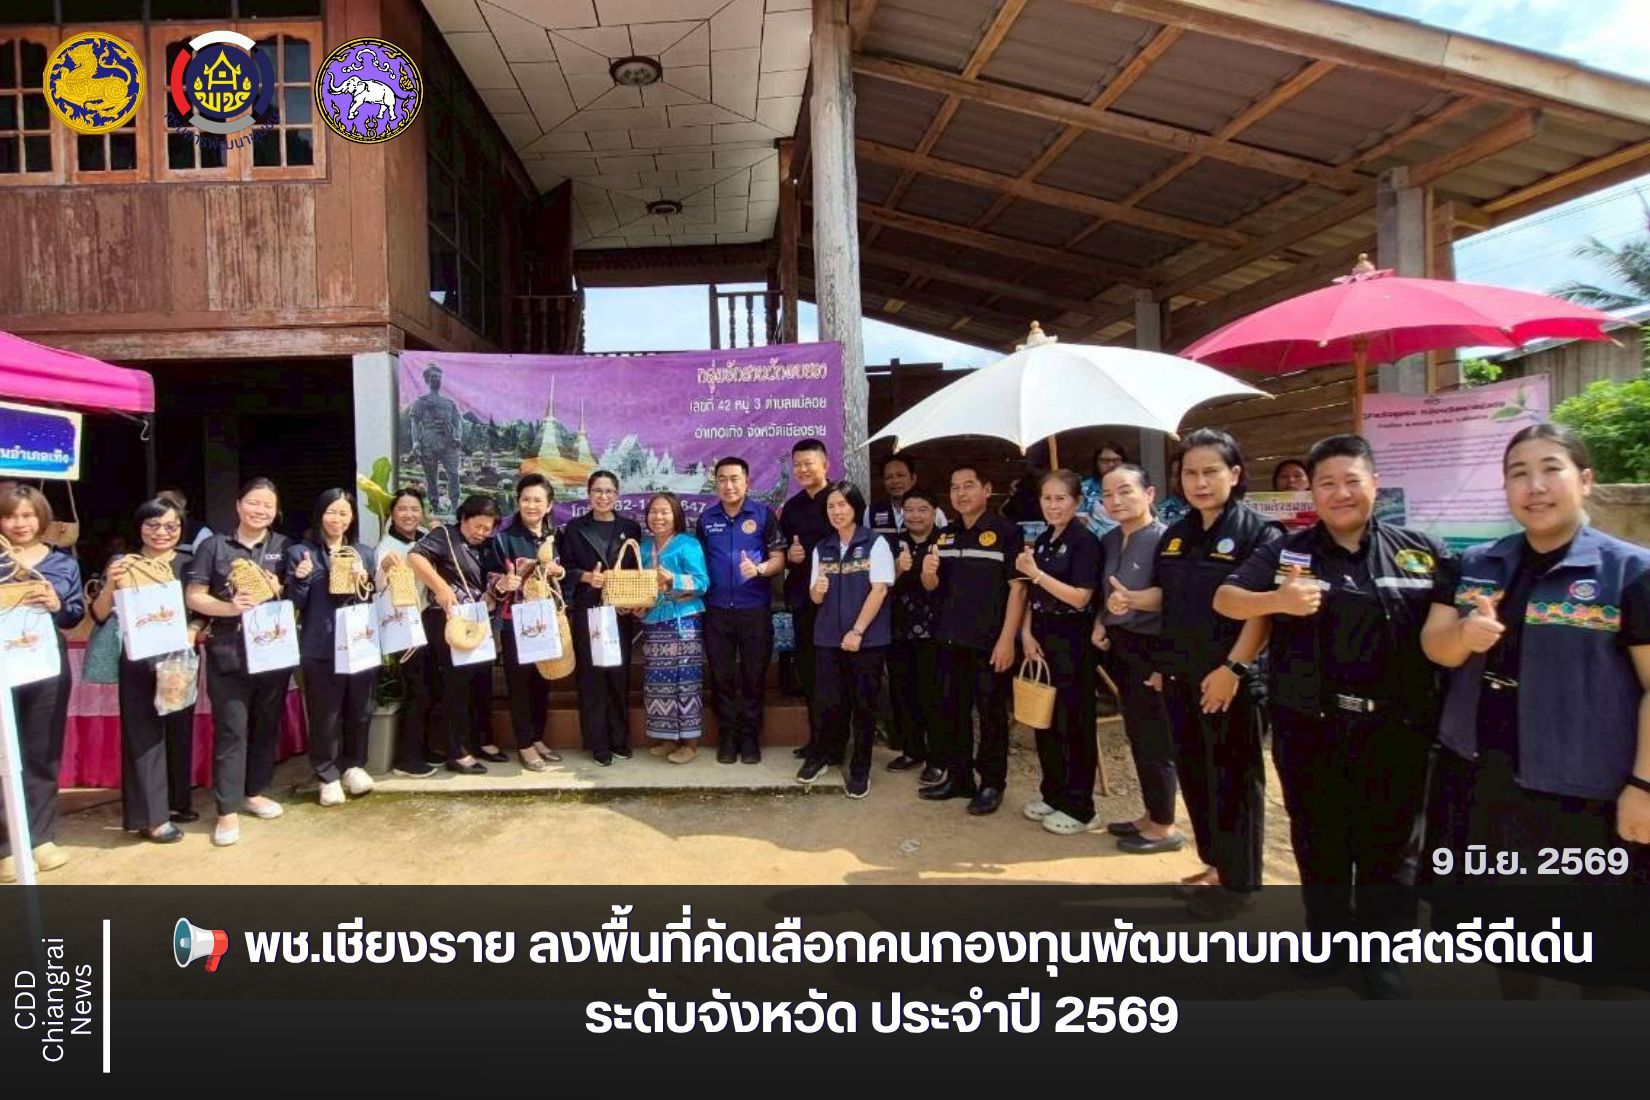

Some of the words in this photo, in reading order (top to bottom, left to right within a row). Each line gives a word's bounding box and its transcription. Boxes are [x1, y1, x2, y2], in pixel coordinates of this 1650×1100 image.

[718, 399, 731, 411] 42
[754, 398, 761, 410] 3
[748, 422, 827, 438] จังหวัดเชียงราย
